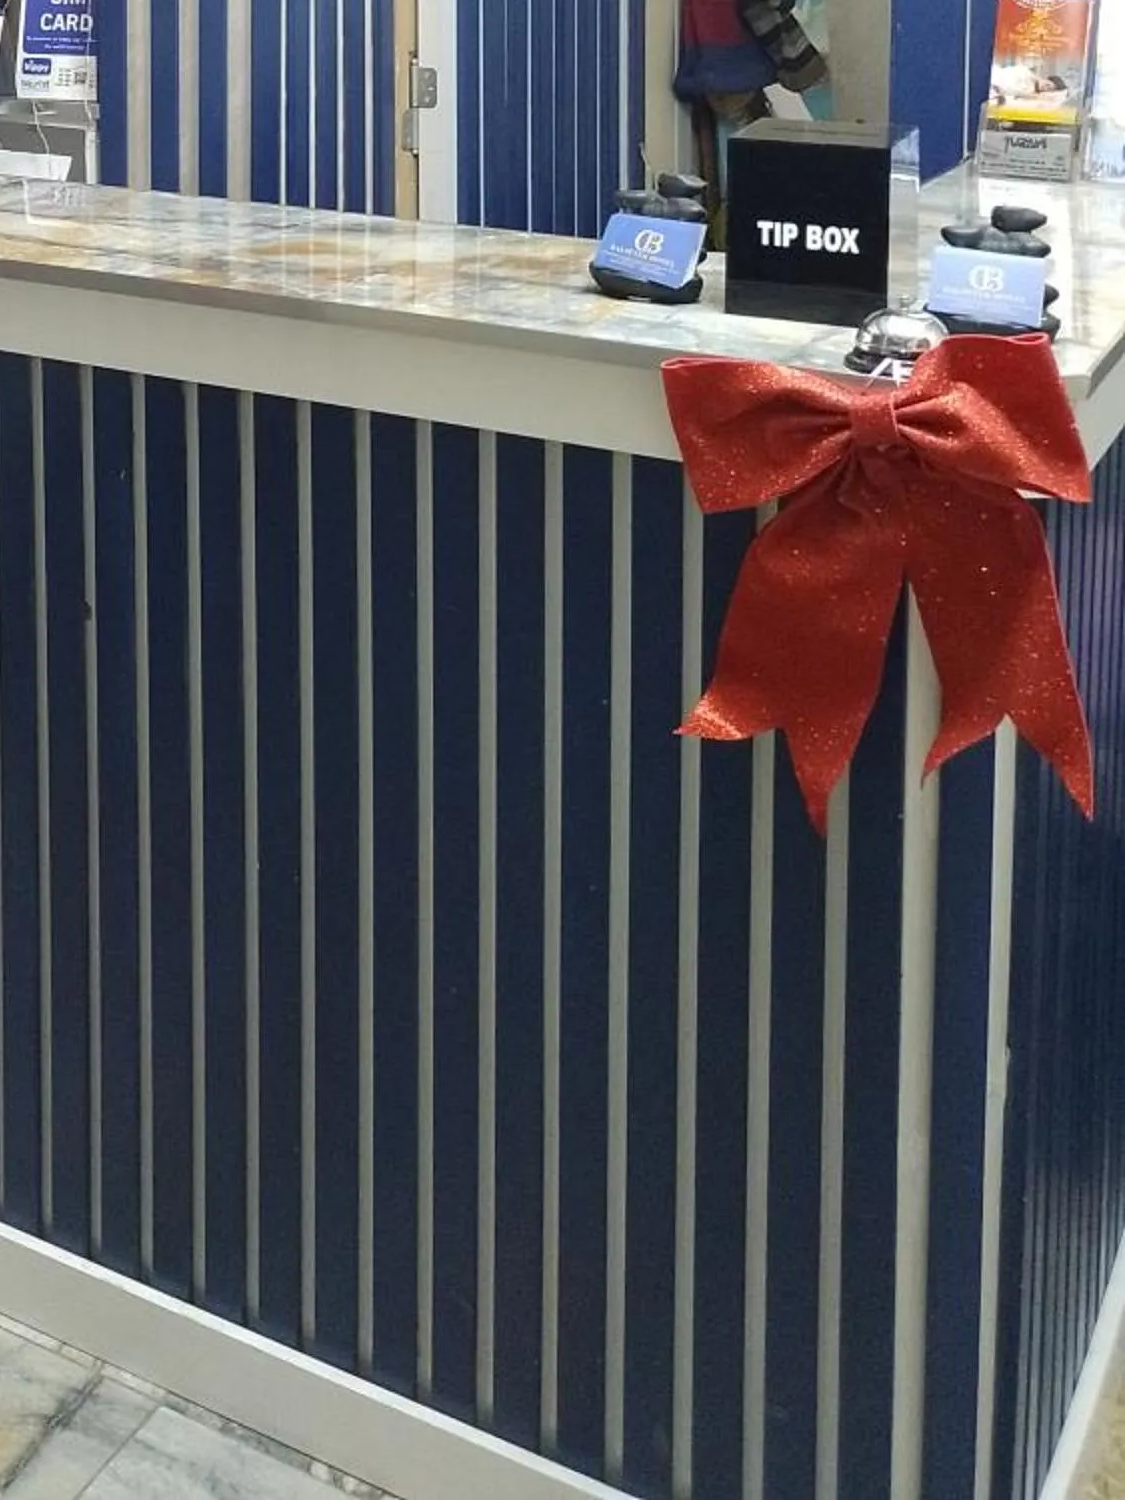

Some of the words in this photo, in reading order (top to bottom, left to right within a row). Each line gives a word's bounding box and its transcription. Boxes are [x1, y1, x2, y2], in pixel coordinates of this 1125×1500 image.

[40, 13, 94, 31] CARD
[756, 220, 799, 248] TIP
[806, 224, 860, 254] BOX
